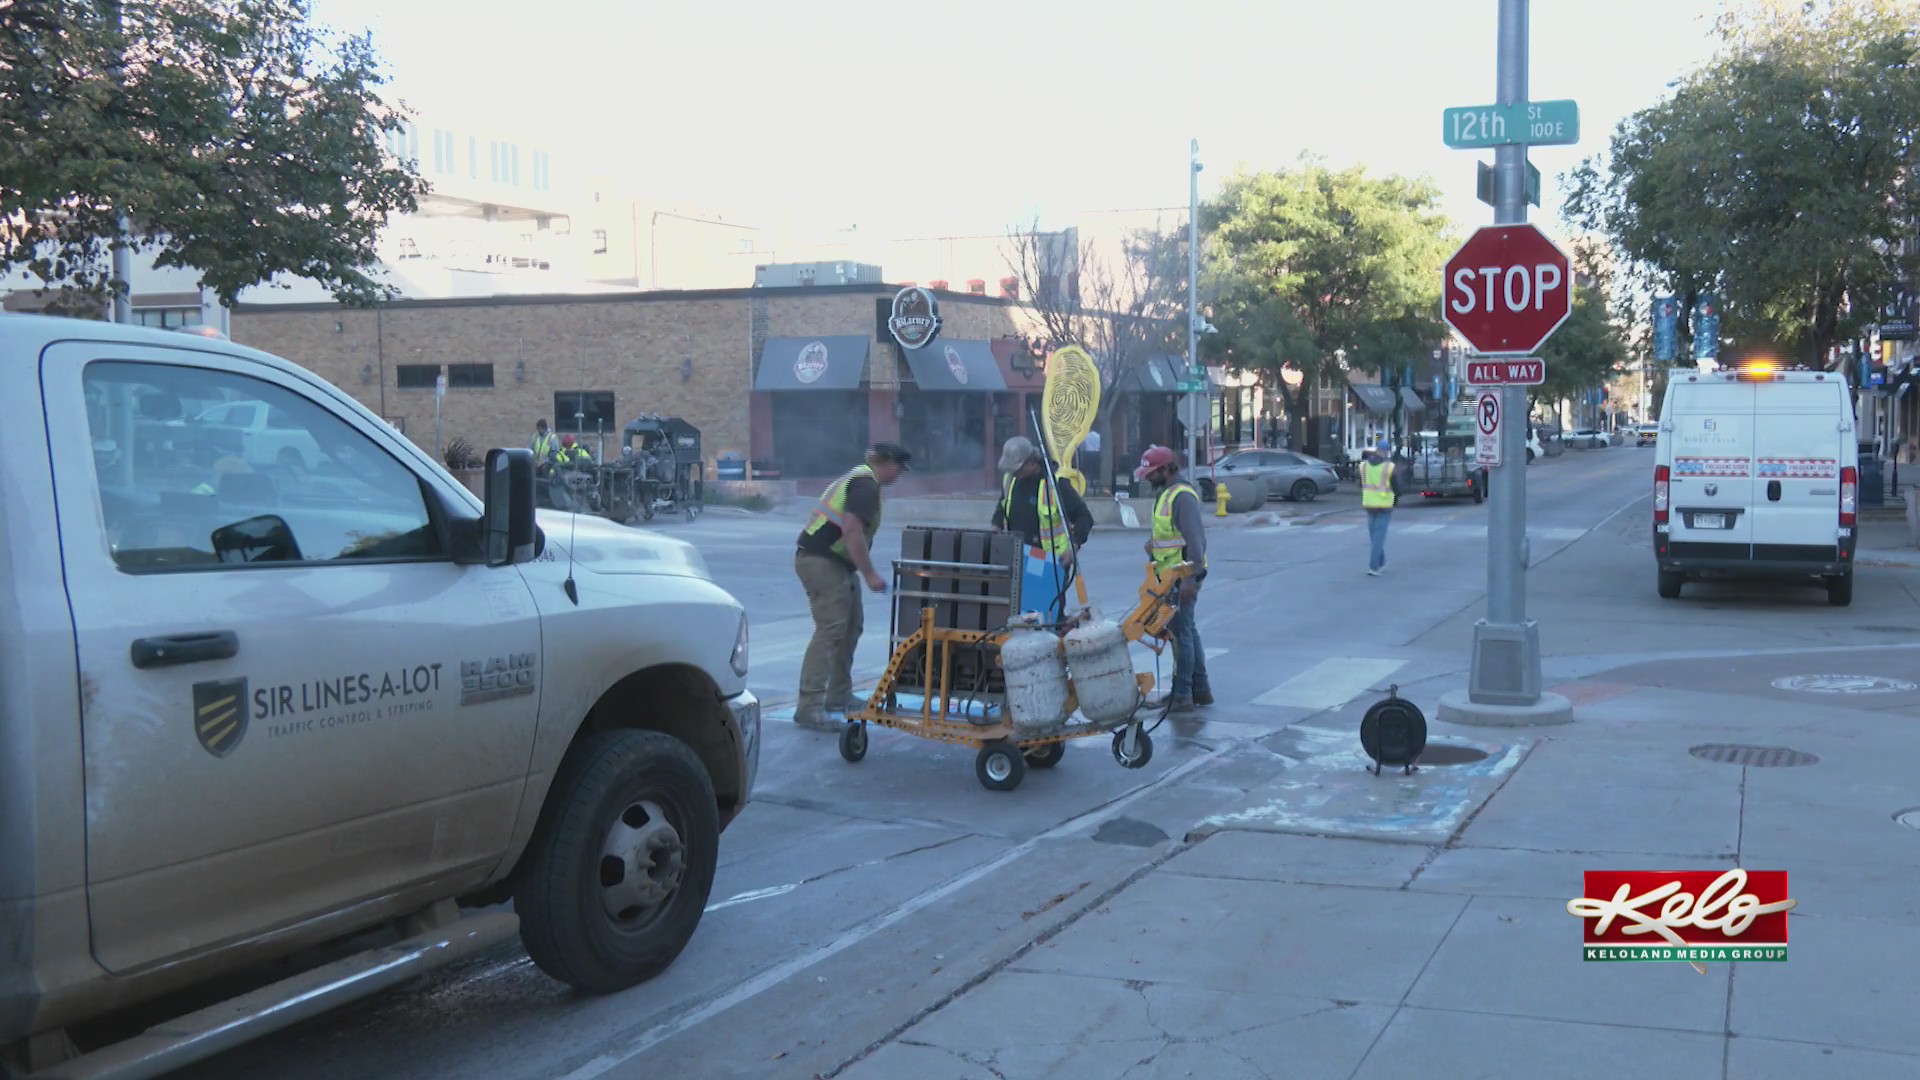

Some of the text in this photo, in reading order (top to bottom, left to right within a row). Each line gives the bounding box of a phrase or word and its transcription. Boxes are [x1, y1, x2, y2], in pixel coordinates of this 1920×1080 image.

[1452, 111, 1506, 141] 12th
[1527, 106, 1542, 120] St
[1530, 122, 1564, 138] 100 E
[1451, 263, 1562, 314] STOP
[1474, 365, 1537, 381] ALL WAY
[460, 652, 536, 676] RAM
[254, 685, 295, 720] SIR
[302, 663, 442, 712] LINES-A-LOT
[268, 700, 433, 739] TRAFFIC CONTROL & STRIPING
